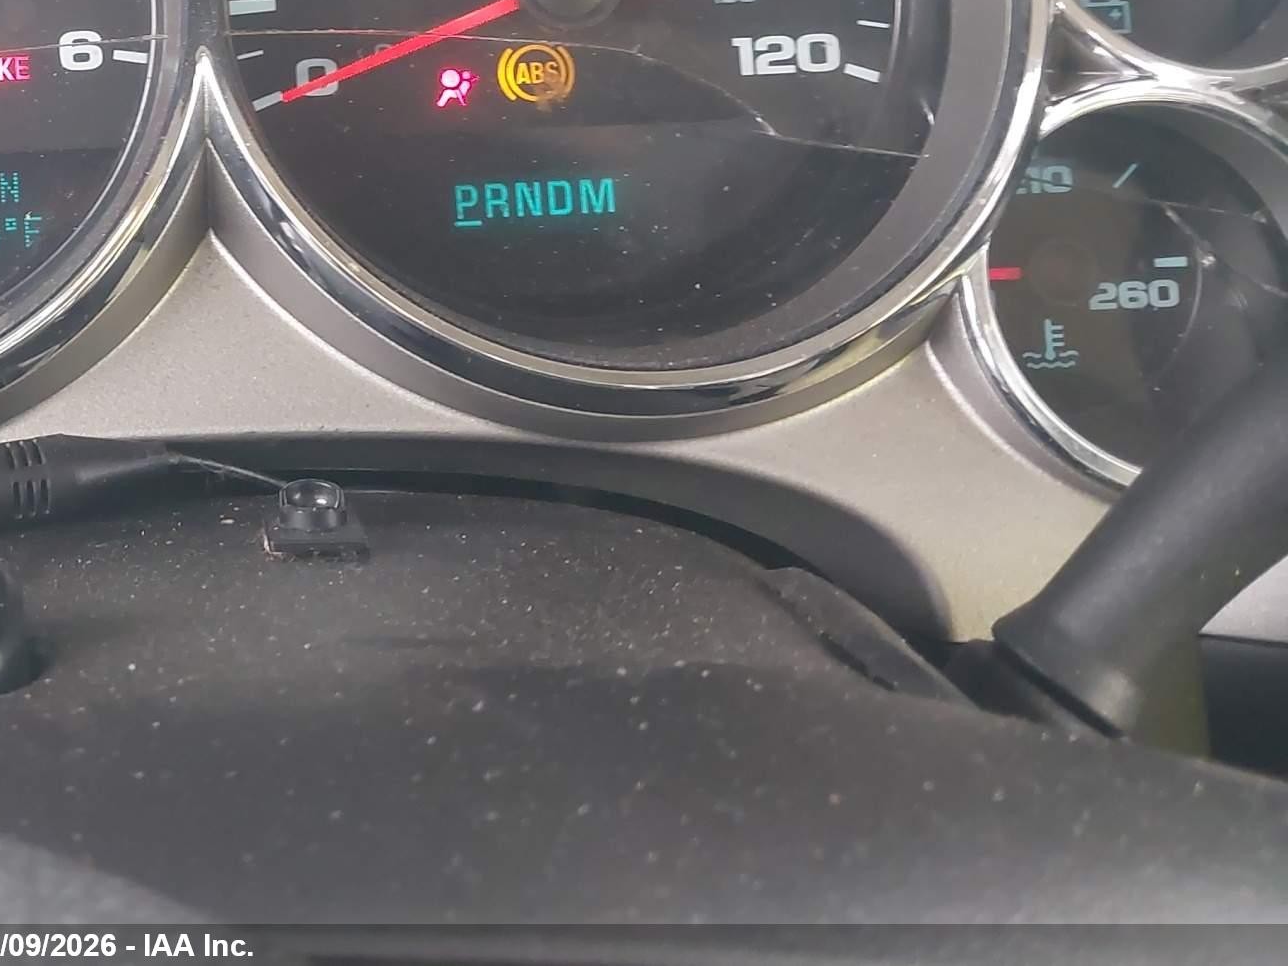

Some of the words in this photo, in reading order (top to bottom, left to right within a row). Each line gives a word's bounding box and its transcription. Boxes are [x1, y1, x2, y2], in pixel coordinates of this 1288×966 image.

[58, 30, 103, 71] 6
[731, 33, 841, 76] 120
[296, 58, 339, 96] 0
[516, 61, 560, 84] ABS
[0, 171, 21, 204] N
[1088, 279, 1180, 310] 260
